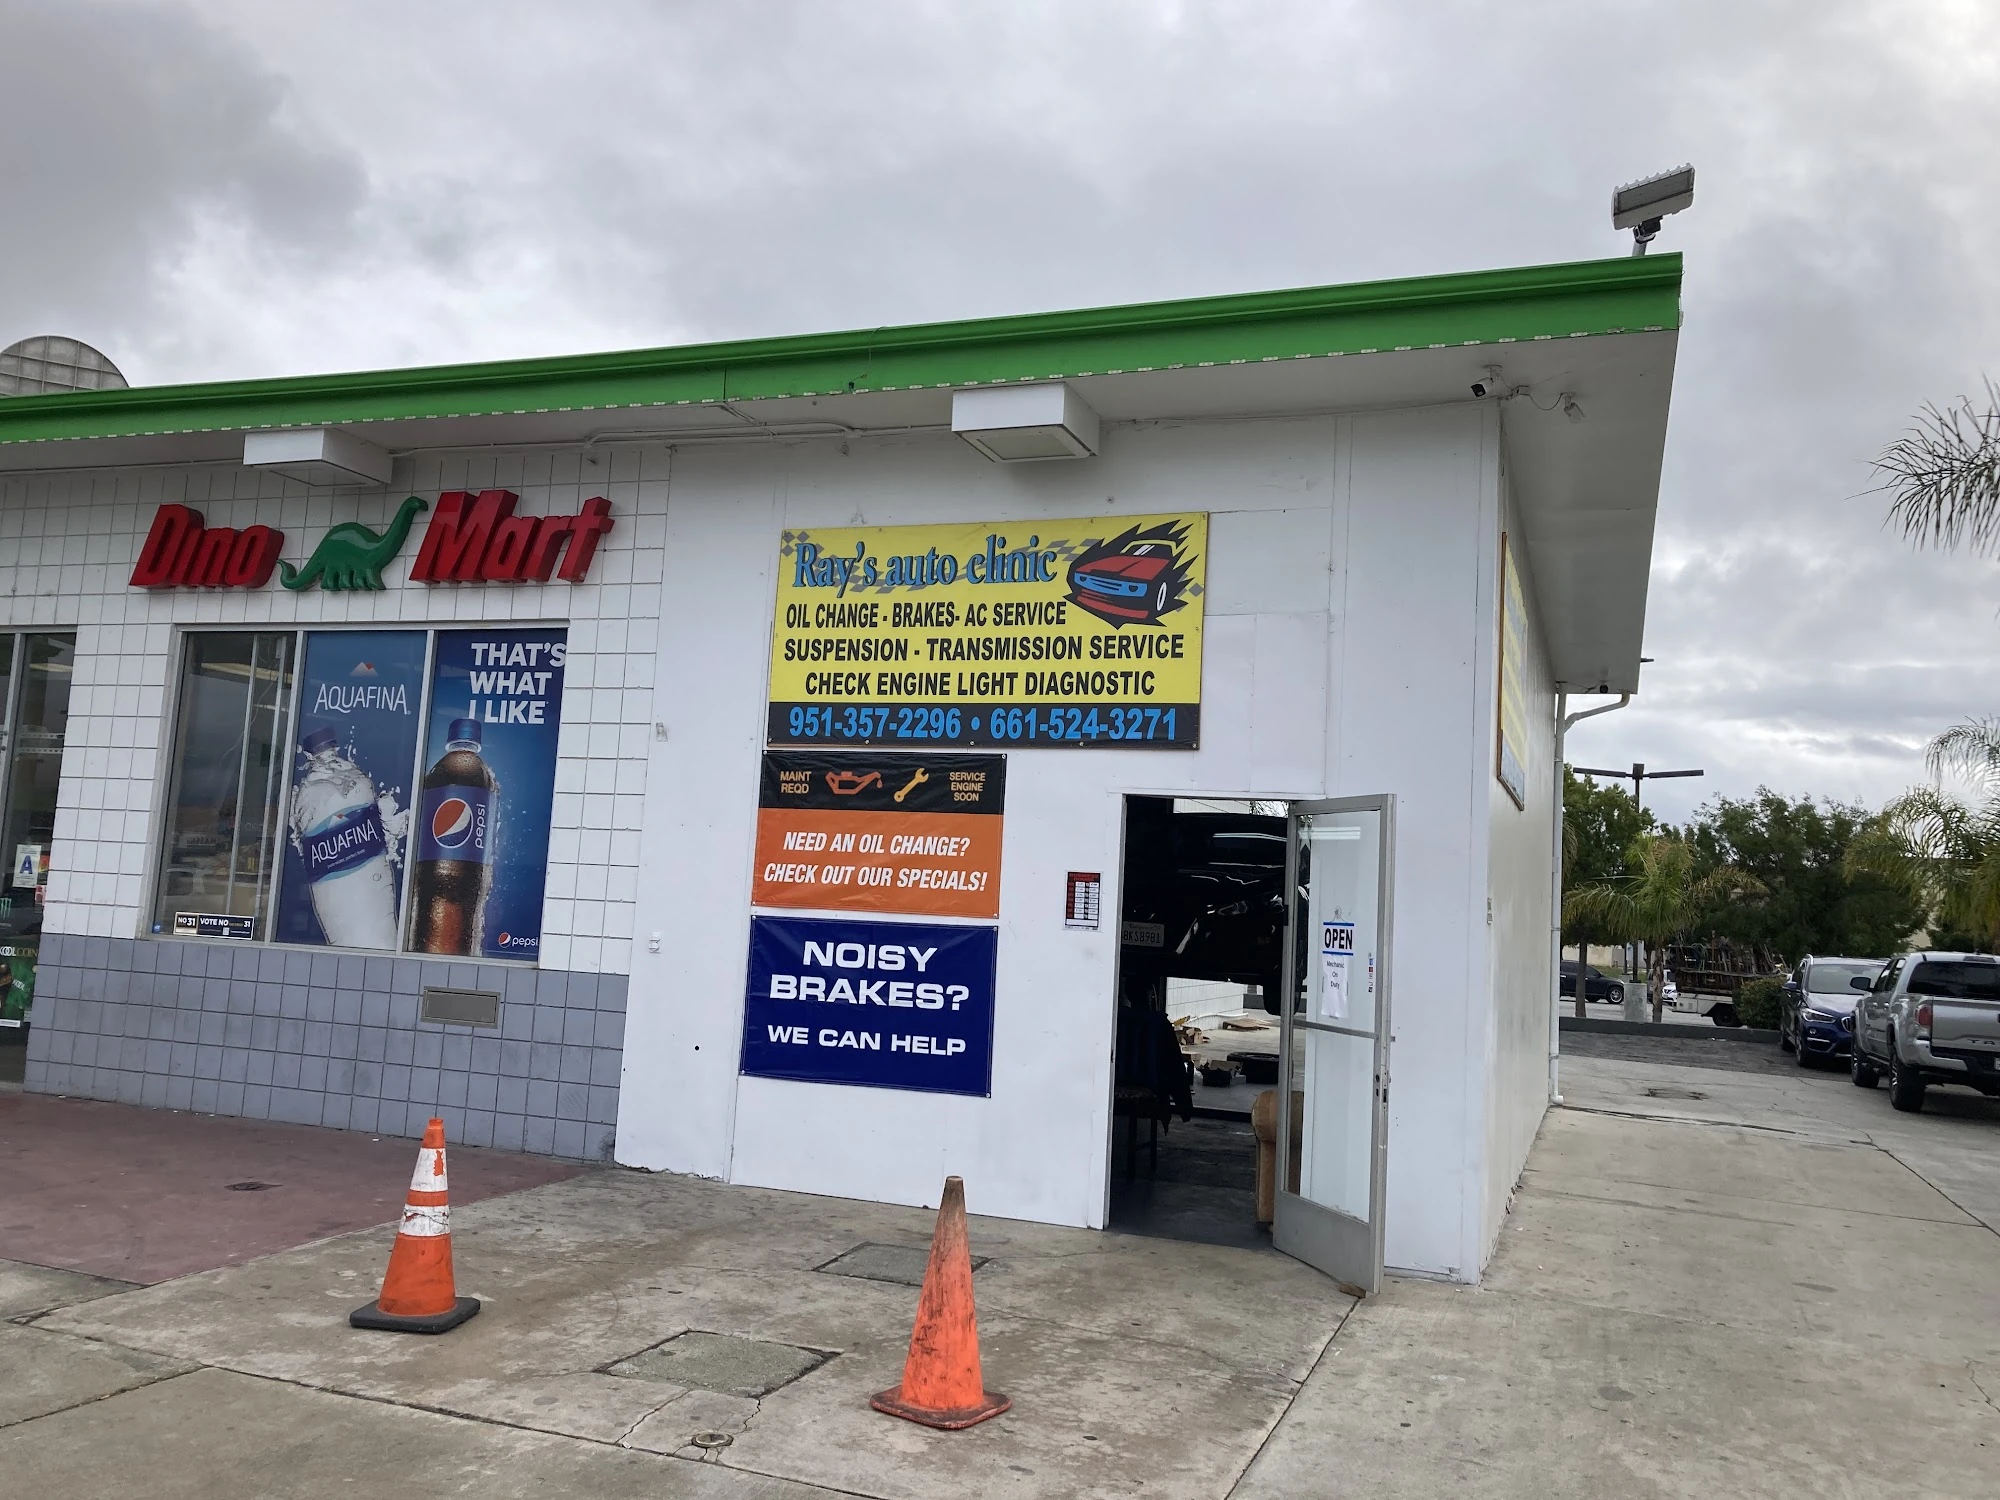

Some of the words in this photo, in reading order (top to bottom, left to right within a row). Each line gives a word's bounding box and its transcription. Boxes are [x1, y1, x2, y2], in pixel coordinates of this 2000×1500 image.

[129, 503, 284, 589] Dino
[409, 489, 615, 583] Mart
[792, 541, 877, 598] Ray's
[885, 546, 958, 586] auto
[967, 534, 1058, 584] clinic
[786, 603, 811, 628] OIL
[815, 603, 879, 628] CHANGE
[964, 603, 987, 627] AC
[993, 601, 1067, 626] SERVICE
[471, 642, 567, 667] THAT'S
[784, 638, 908, 661] SUSPENSION
[926, 636, 1082, 661] TRANSMISSION
[1089, 634, 1184, 659] SERVICE
[470, 671, 553, 695] WHAT
[805, 673, 871, 695] CHECK
[876, 672, 951, 695] ENGINE
[957, 672, 1018, 695] LIGHT
[1025, 671, 1156, 696] DIAGNOSTIC
[314, 684, 408, 715] AQUAFINA
[468, 700, 477, 720] I
[484, 700, 546, 724] LIKE
[789, 707, 962, 740] 951-357-2296
[989, 708, 1177, 741] 661-524-3271
[780, 771, 812, 783] MAINT
[780, 782, 809, 795] REQD
[949, 772, 986, 783] SERVICE
[950, 782, 983, 792] ENGINE
[953, 791, 979, 802] SOON
[475, 803, 486, 849] pepsi
[311, 818, 379, 869] AQUAFINA
[783, 831, 826, 852] NEED
[830, 833, 854, 853] AN
[858, 834, 885, 854] OIL
[889, 835, 970, 857] CHANGE?
[19, 855, 33, 874] A
[764, 863, 816, 884] CHECK
[821, 865, 855, 885] OUT
[857, 867, 892, 887] OUR
[896, 868, 987, 892] SPECIALS!
[186, 917, 196, 927] 31
[218, 918, 229, 926] NO
[244, 920, 251, 928] 31
[512, 936, 538, 948] pepsi
[1324, 928, 1353, 950] OPEN
[802, 940, 937, 972] NOISY
[1326, 960, 1345, 969] Mechanic
[769, 974, 970, 1011] BRAKES?
[1330, 981, 1340, 989] Duty
[767, 1025, 809, 1045] WE
[818, 1029, 881, 1050] CAN
[891, 1034, 966, 1056] HELP
